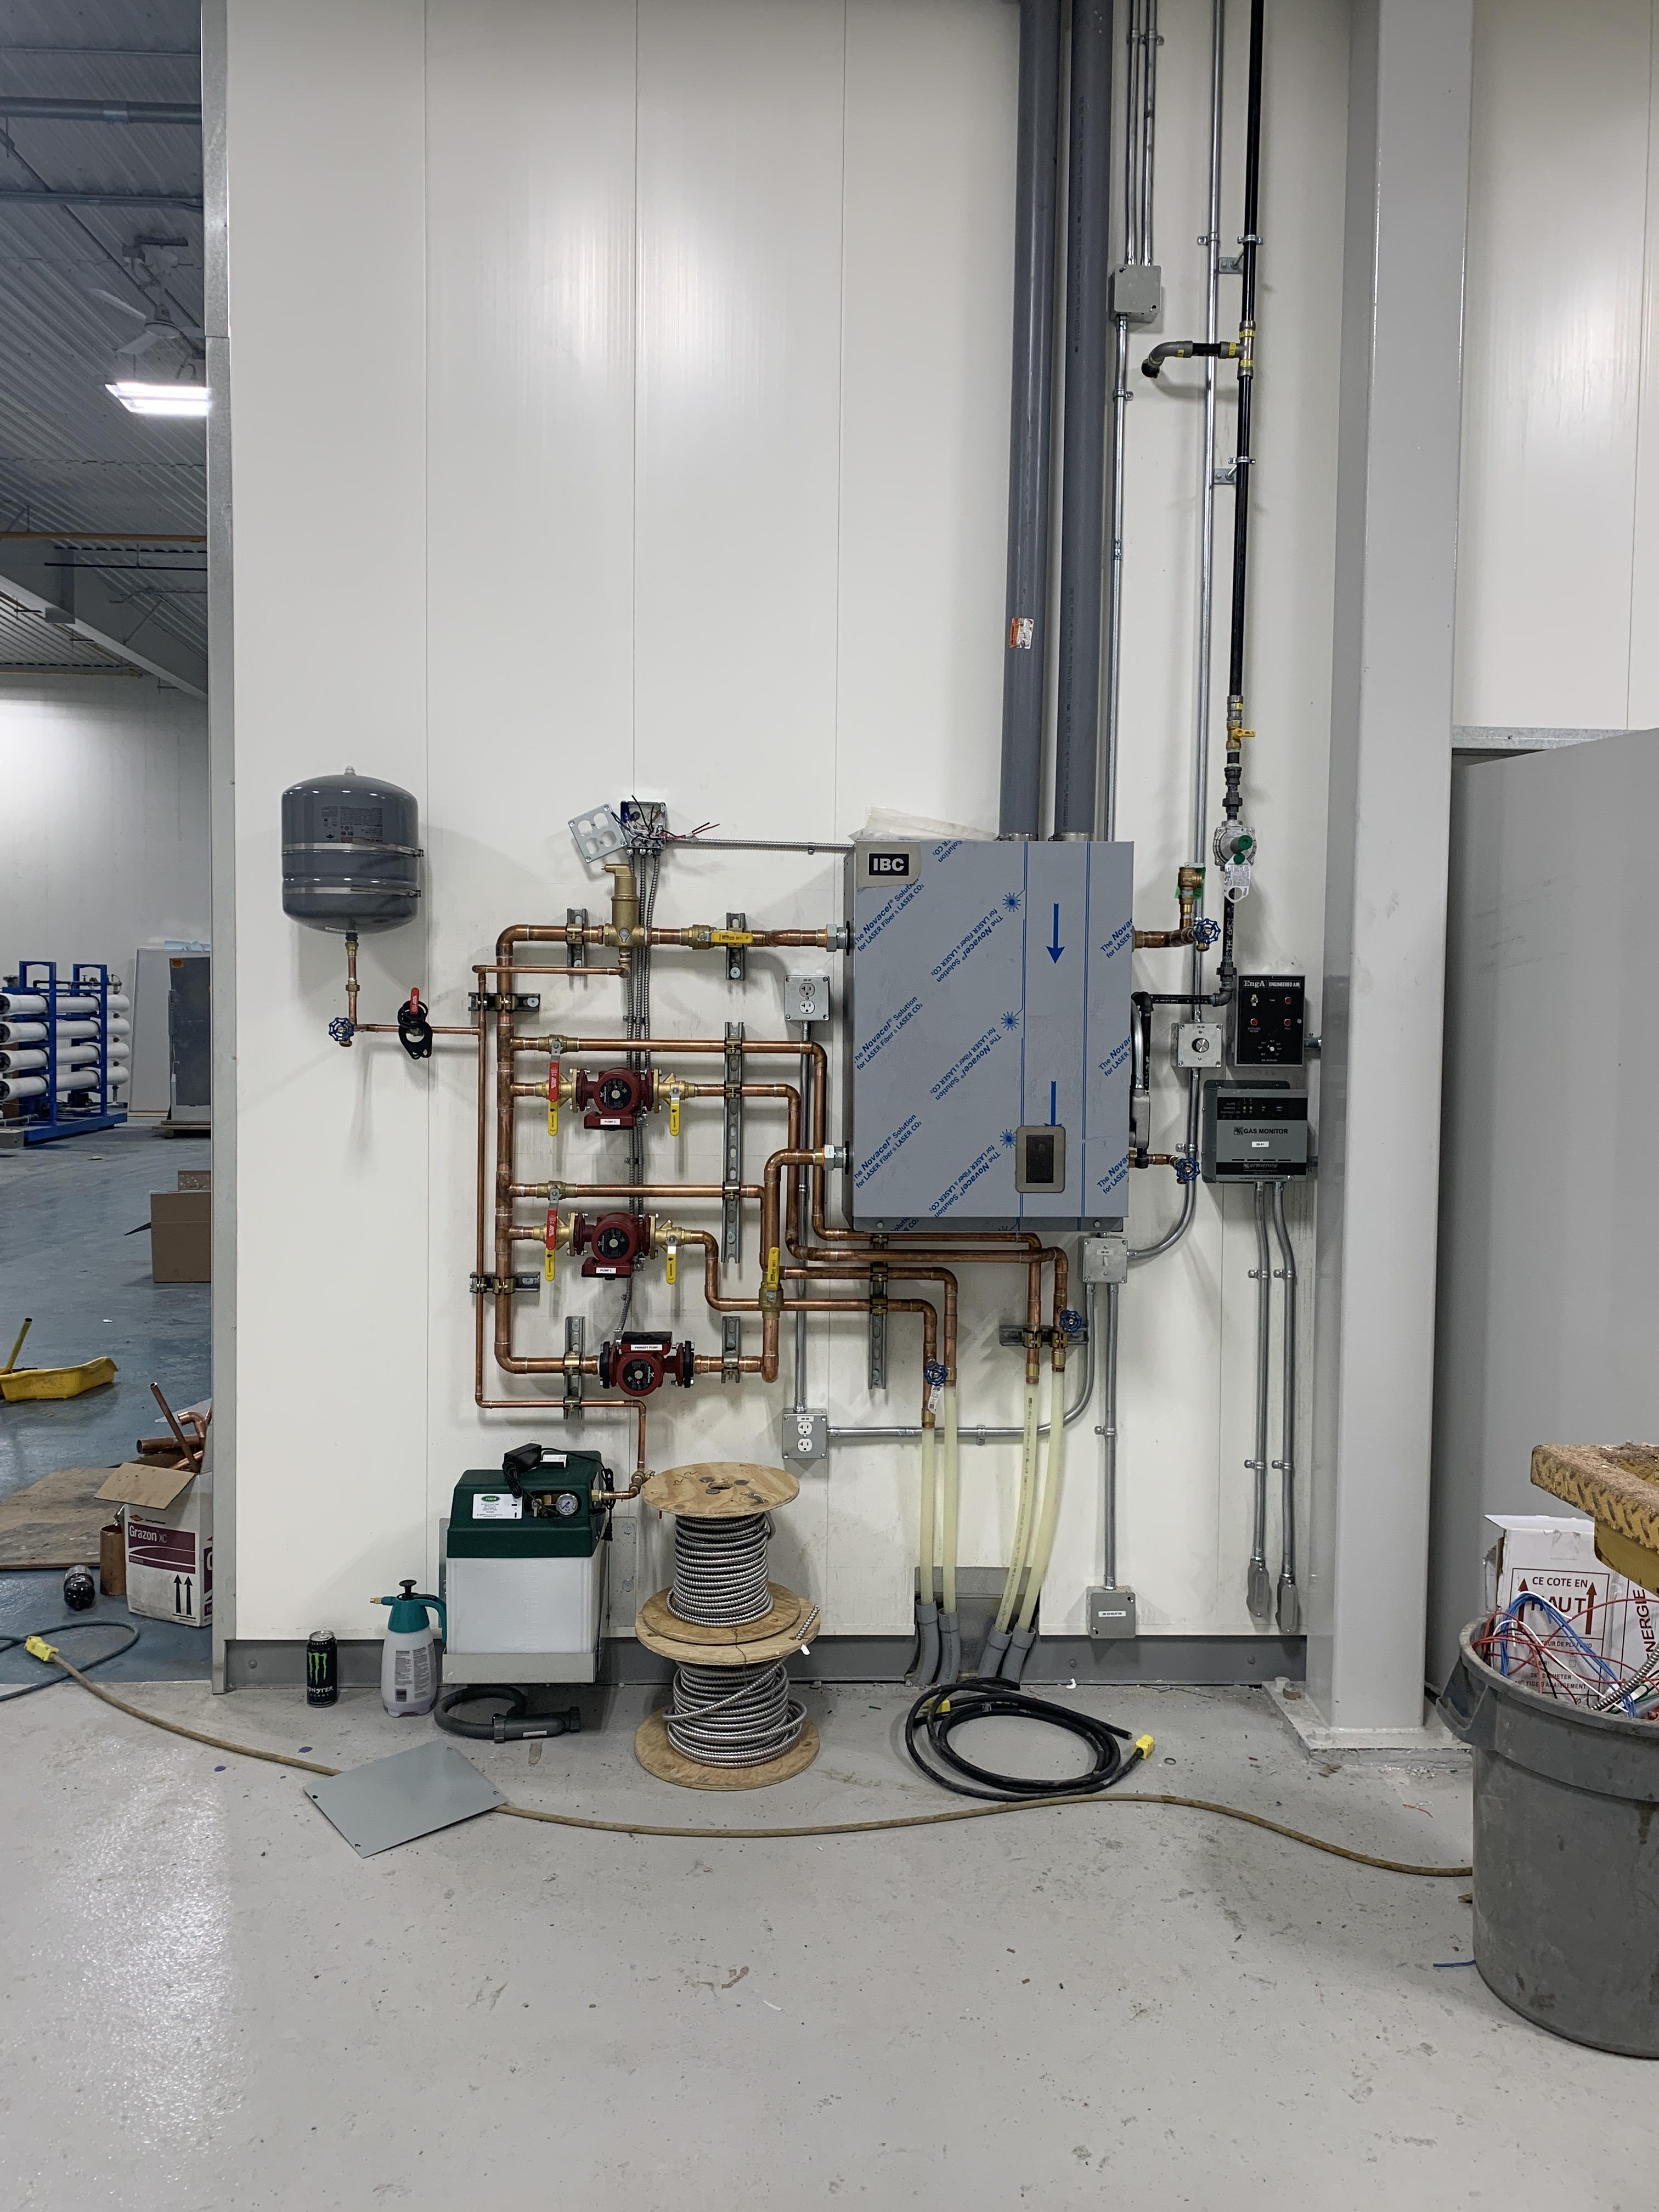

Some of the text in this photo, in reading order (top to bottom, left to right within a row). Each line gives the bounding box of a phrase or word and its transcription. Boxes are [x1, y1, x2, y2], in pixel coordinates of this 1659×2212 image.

[873, 858, 904, 871] IBC
[857, 942, 866, 952] for
[866, 927, 883, 944] LASER
[881, 913, 895, 927] Fiber
[898, 892, 915, 911] LASER
[989, 909, 997, 918] for
[991, 916, 1003, 926] The
[972, 916, 990, 934] LASER
[855, 933, 865, 945] he
[960, 933, 974, 947] Fiber
[1100, 940, 1113, 951] The
[1106, 933, 1132, 958] for LASER
[940, 949, 958, 967] LASER
[936, 958, 961, 982] Solution
[854, 1052, 864, 1063] he
[893, 997, 917, 1020] Solution
[988, 1027, 996, 1036] for
[857, 1061, 866, 1070] for
[865, 1045, 882, 1062] LASER
[880, 1032, 894, 1046] Fiber
[896, 1012, 913, 1029] LASER
[971, 1035, 989, 1053] LASER
[989, 1034, 1002, 1045] The
[959, 1051, 973, 1065] Fiber
[1098, 1059, 1111, 1070] The
[1104, 1052, 1130, 1076] for LASER
[939, 1068, 957, 1085] LASER
[935, 1077, 960, 1101] Solution
[854, 1170, 862, 1181] he
[892, 1115, 916, 1138] Solution
[986, 1145, 995, 1154] for
[856, 1179, 865, 1188] for
[864, 1163, 881, 1180] LASER
[879, 1150, 893, 1164] Fiber
[895, 1130, 912, 1148] LASER
[970, 1153, 988, 1170] LASER
[988, 1152, 1001, 1163] The
[958, 1169, 972, 1183] Fiber
[1097, 1176, 1110, 1187] The
[1103, 1169, 1128, 1194] for LASER
[938, 1185, 956, 1203] LASER
[934, 1194, 958, 1218] Solution
[159, 1533, 167, 1543] XC
[1532, 1577, 1588, 1588] CE COTE EN
[1633, 1589, 1656, 1659] NERGIE
